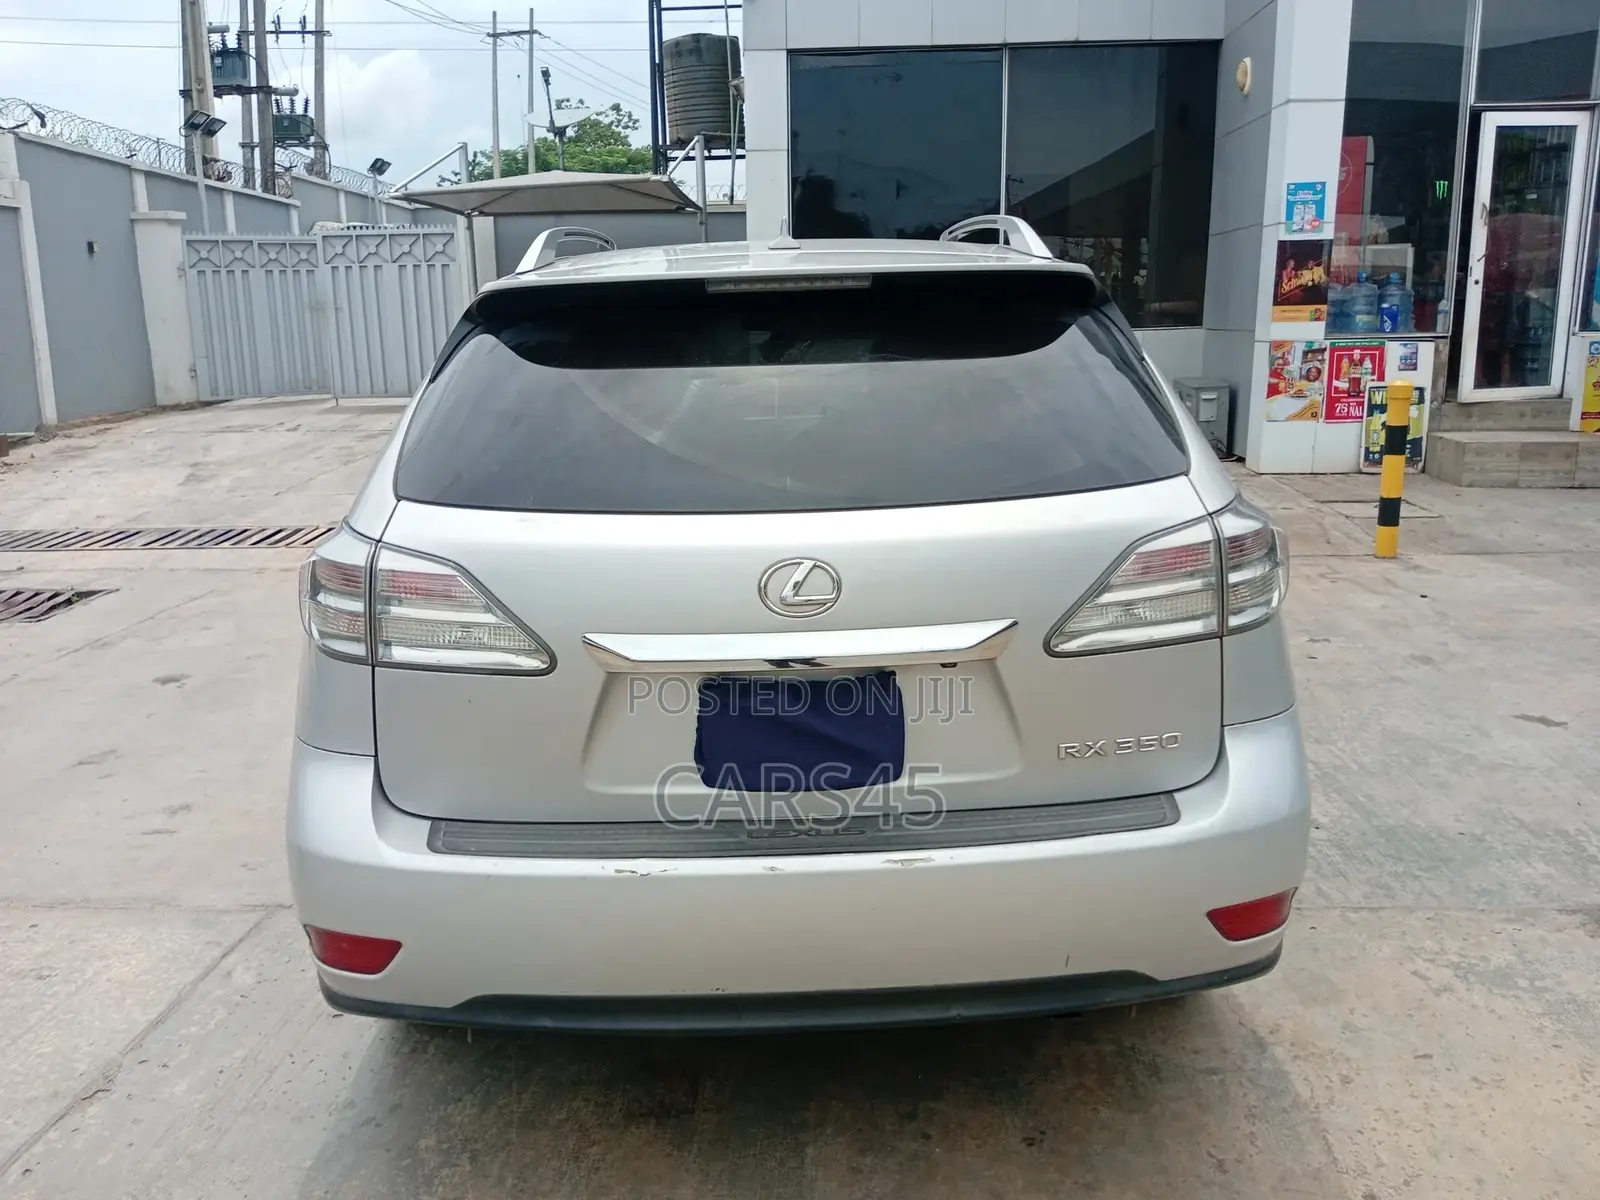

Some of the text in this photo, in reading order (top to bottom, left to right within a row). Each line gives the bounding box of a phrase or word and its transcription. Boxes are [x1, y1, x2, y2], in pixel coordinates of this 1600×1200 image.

[1335, 403, 1348, 414] 75
[1058, 732, 1182, 759] RX 350
